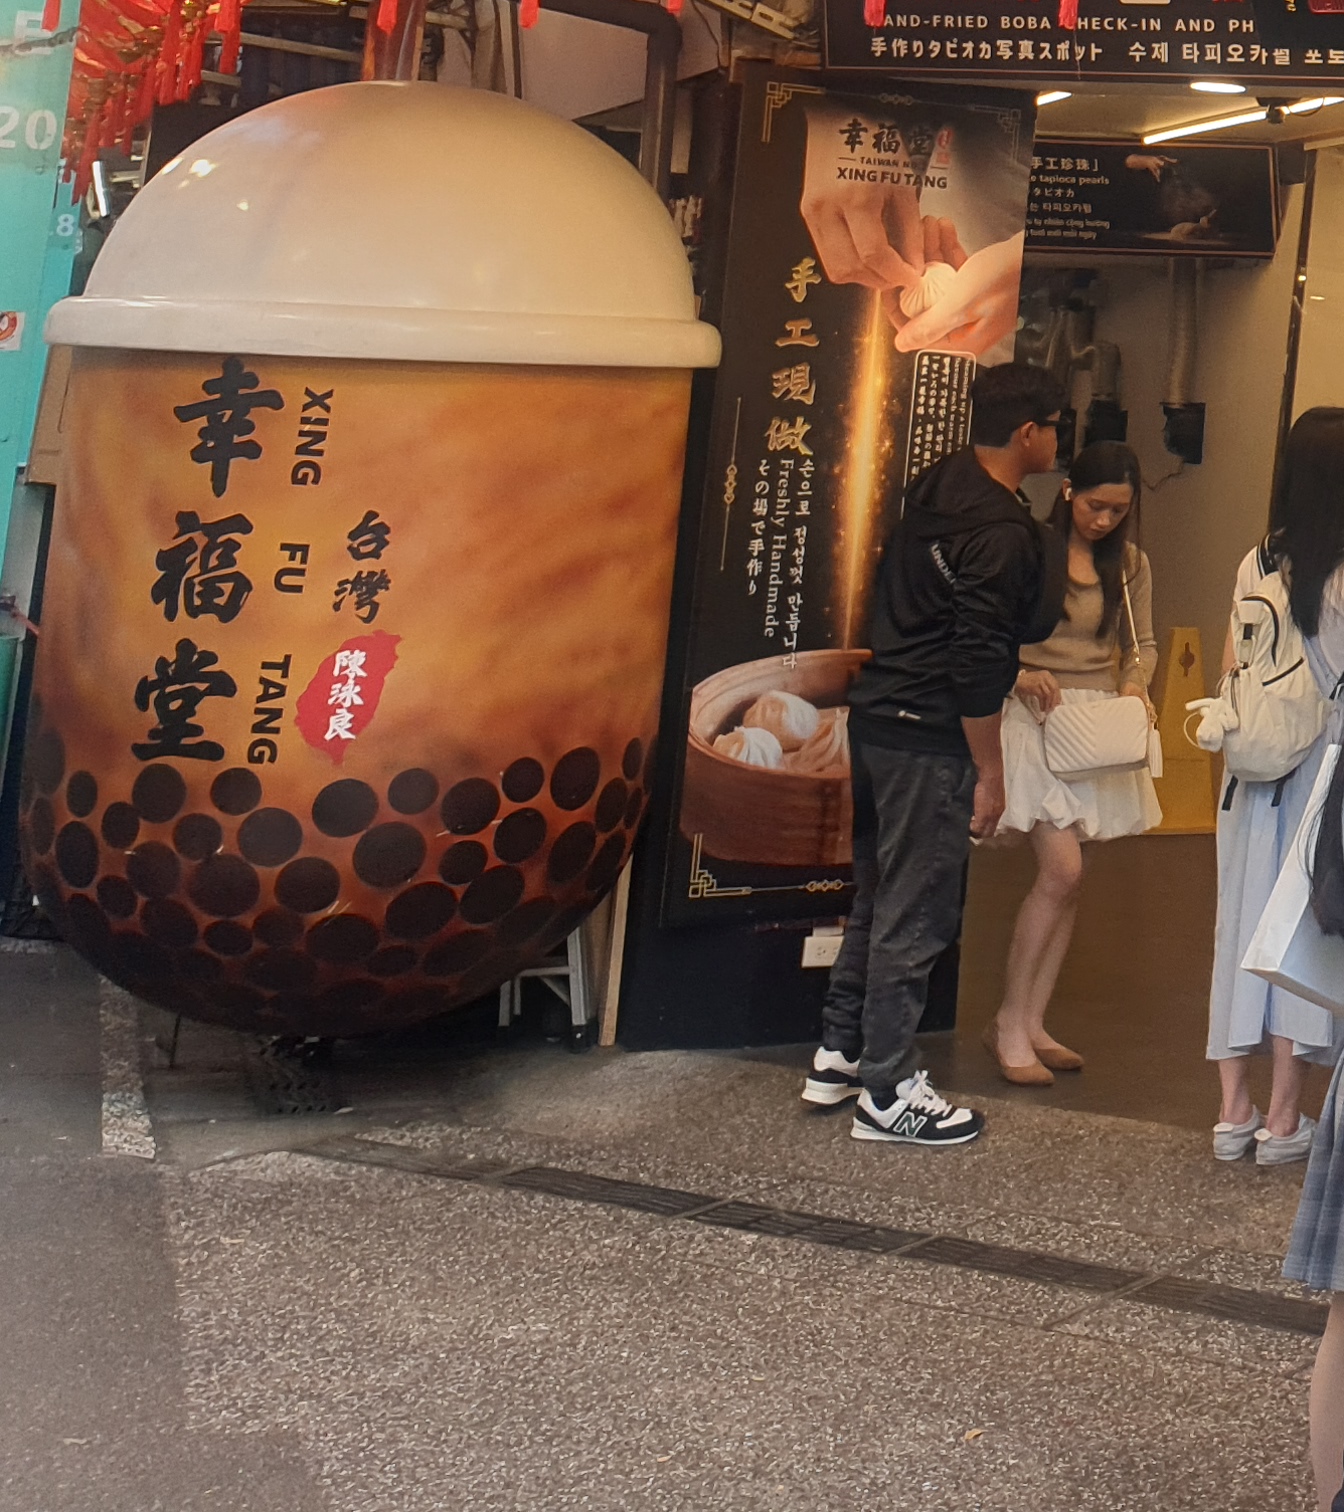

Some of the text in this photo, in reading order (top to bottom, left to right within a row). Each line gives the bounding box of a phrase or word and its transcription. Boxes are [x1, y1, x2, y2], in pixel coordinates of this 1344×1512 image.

[866, 14, 989, 29] AND-FRIED
[1000, 16, 1051, 29] BOBA
[1062, 17, 1162, 31] HECK-IN
[1174, 18, 1215, 32] AND
[870, 36, 1103, 61] 手作りタピオカ写真スポット
[1128, 42, 1169, 63] 수제
[838, 118, 935, 156] 幸福堂
[860, 156, 900, 168] TAIWAN
[836, 167, 948, 189] XING FU TANG
[1039, 174, 1076, 185] tapioca
[1078, 175, 1110, 186] pearls
[765, 256, 822, 456] 手工現做
[131, 355, 284, 763] 幸福堂
[747, 459, 771, 596] その場で手作り
[763, 458, 795, 638] Freshly Handmade
[246, 385, 335, 767] XING FU TANG
[333, 509, 394, 625] 台灣
[322, 649, 367, 742] 陳泳良
